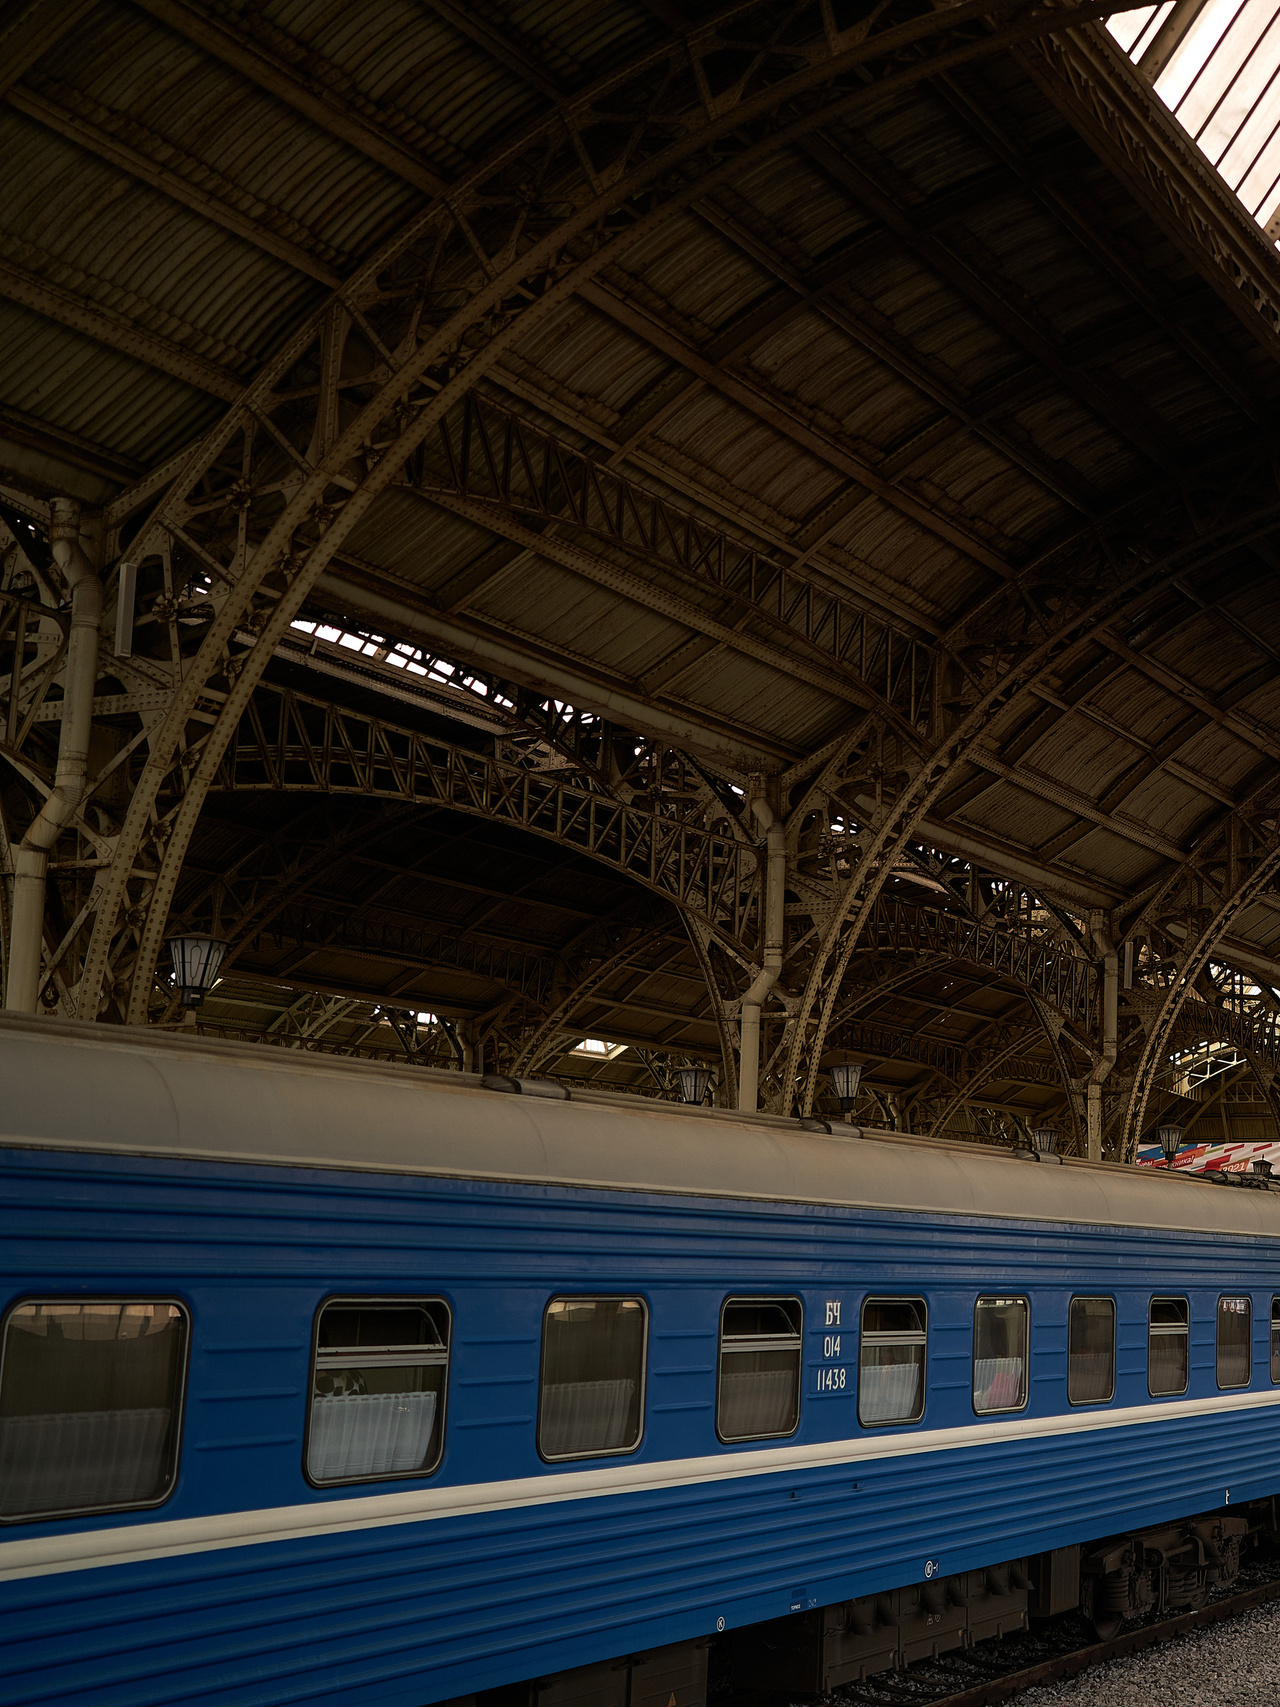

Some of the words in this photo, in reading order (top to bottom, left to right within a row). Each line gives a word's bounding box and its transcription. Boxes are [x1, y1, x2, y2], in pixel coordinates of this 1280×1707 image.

[1222, 1161, 1245, 1173] 2021
[824, 1335, 841, 1357] 014
[817, 1368, 846, 1391] 11438
